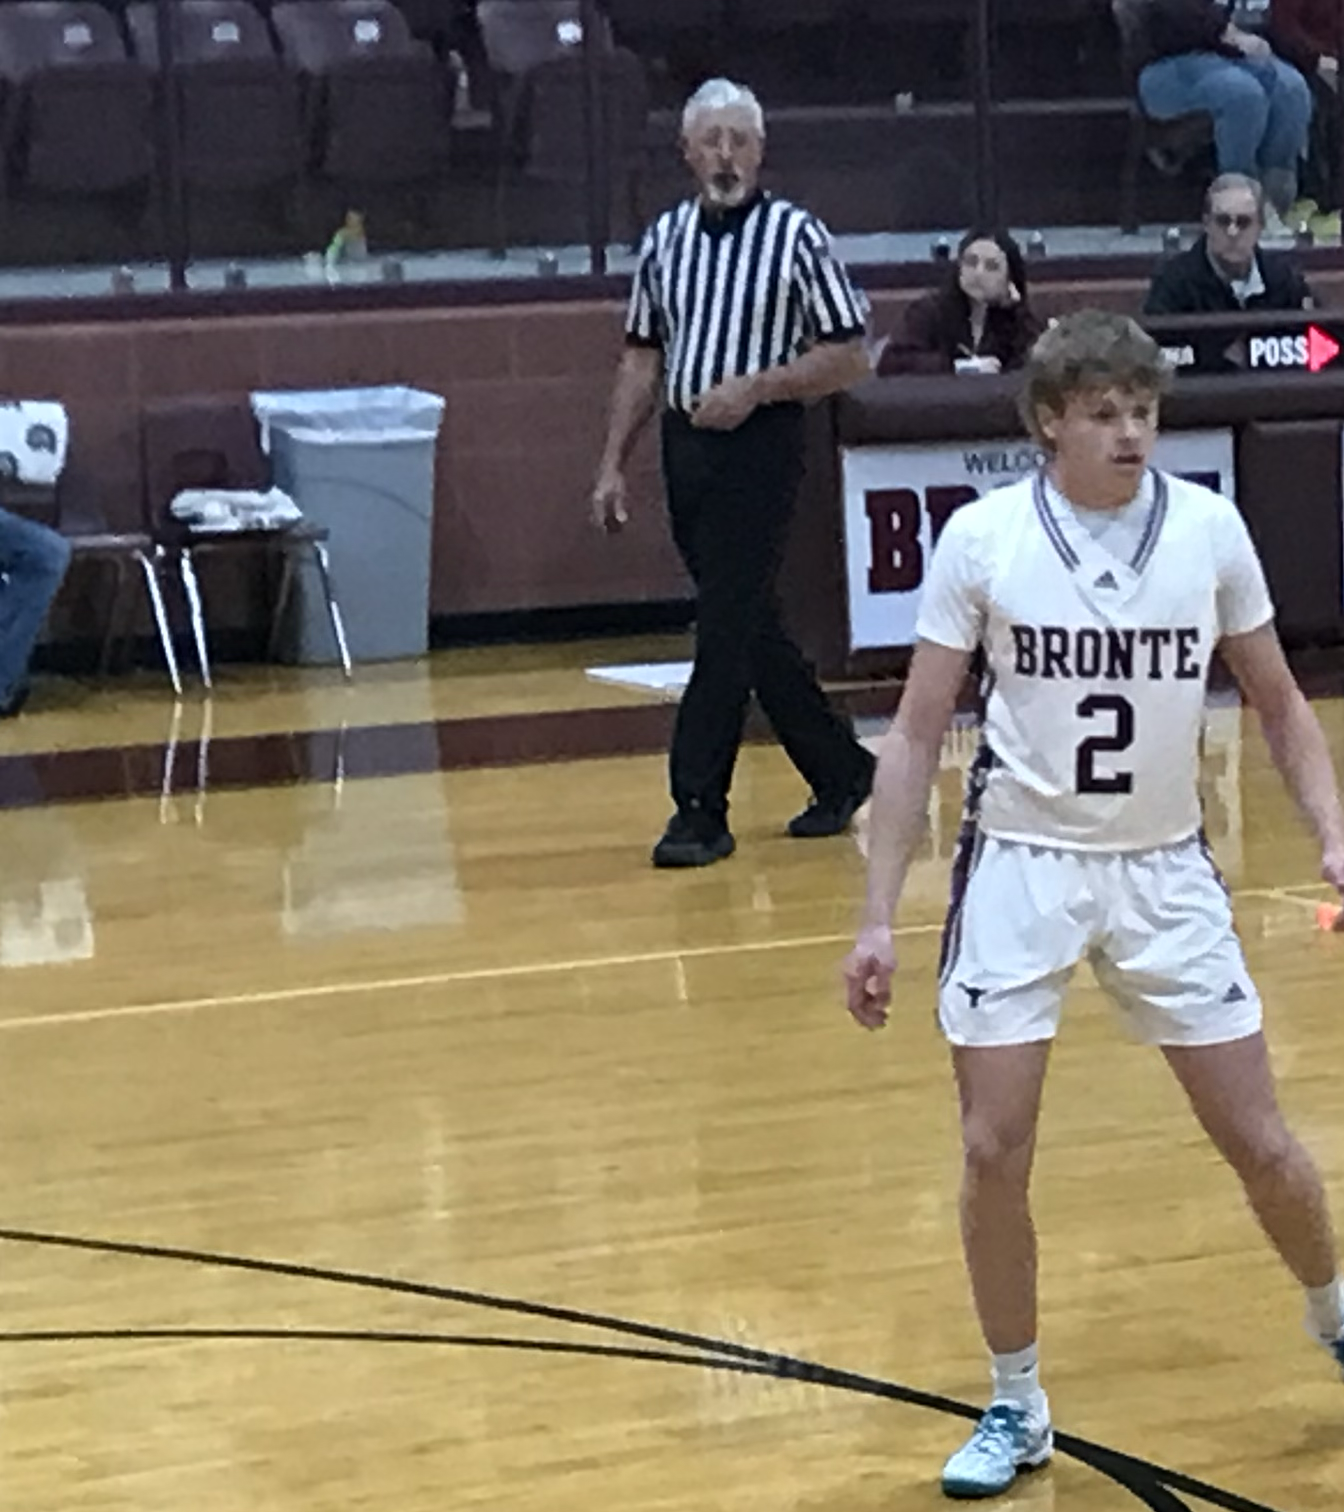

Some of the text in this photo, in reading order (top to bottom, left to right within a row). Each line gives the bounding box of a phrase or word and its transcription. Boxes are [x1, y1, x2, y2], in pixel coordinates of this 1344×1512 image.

[1250, 335, 1309, 367] POSS
[1010, 624, 1201, 680] BRONTE
[1075, 693, 1135, 795] 2
